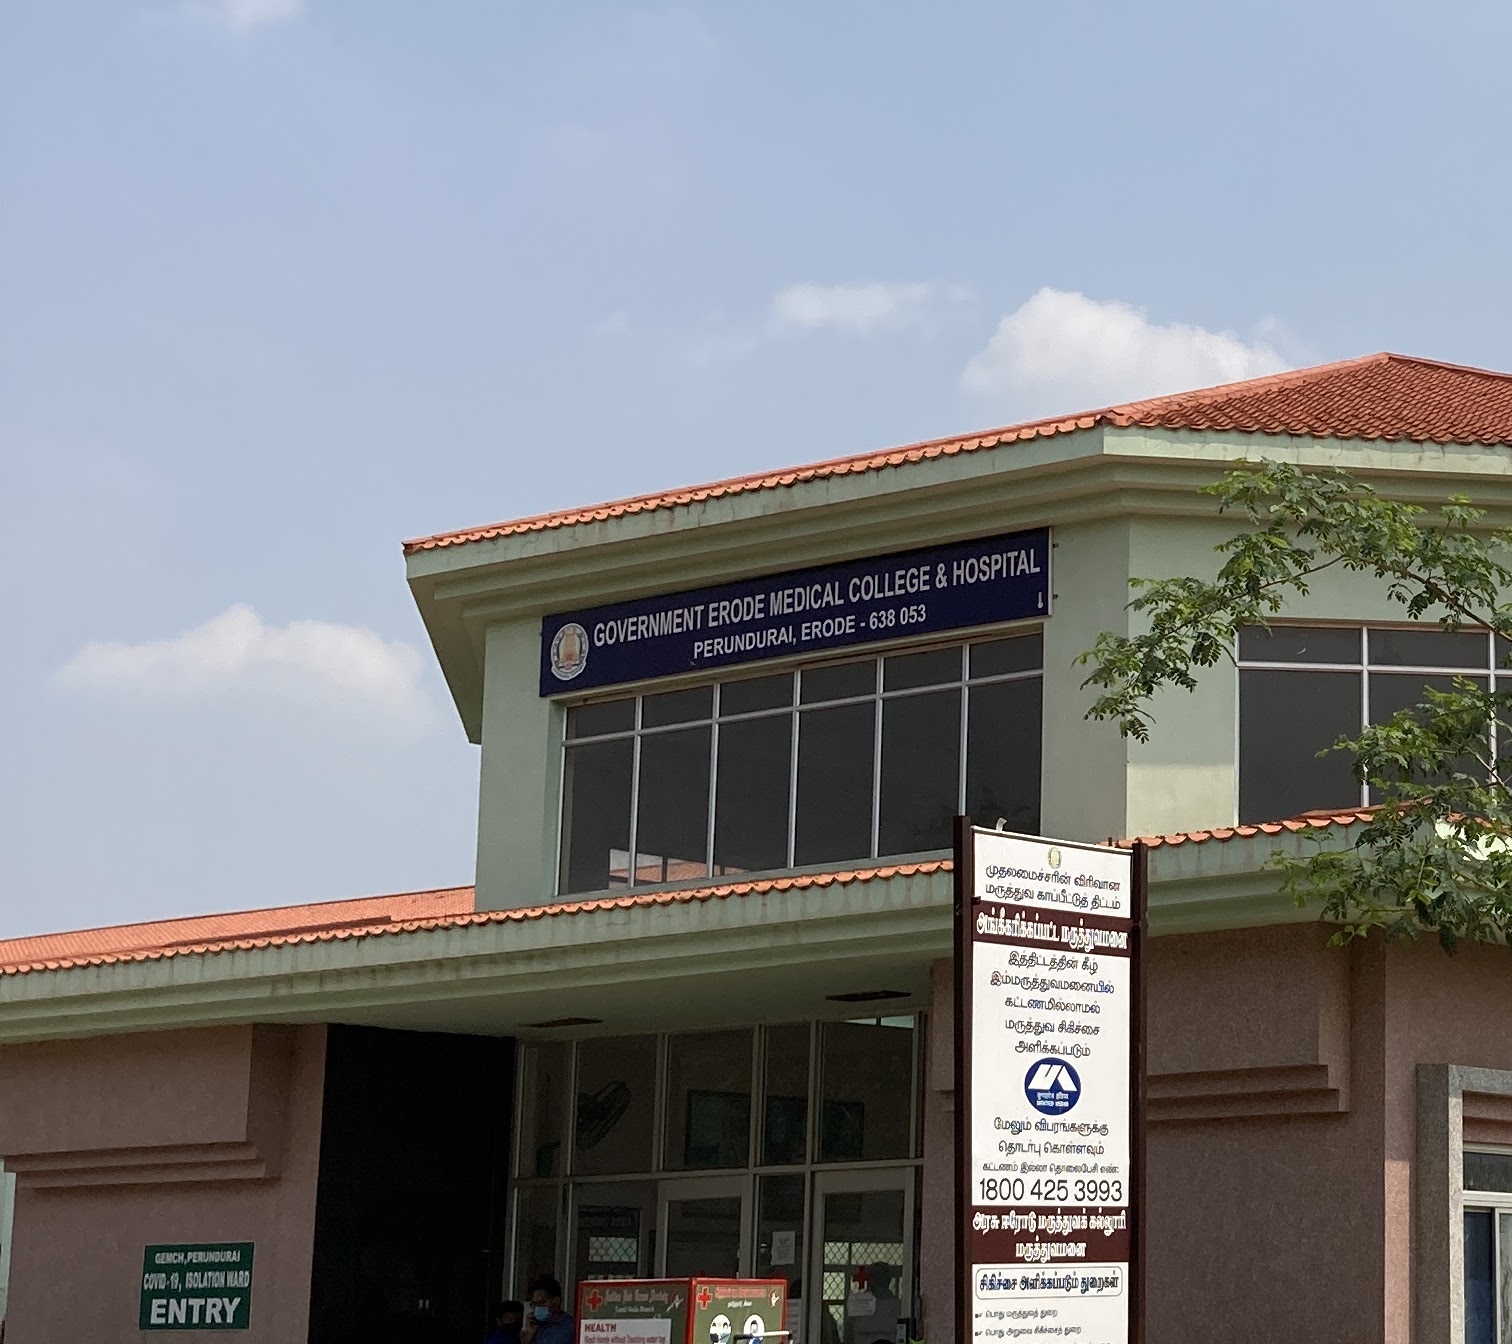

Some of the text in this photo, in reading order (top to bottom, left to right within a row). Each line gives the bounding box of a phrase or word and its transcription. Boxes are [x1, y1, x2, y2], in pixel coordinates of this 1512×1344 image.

[593, 548, 1040, 647] GOVERNMENT ERODE MEDICAL COLLEGE & HOSPITAL
[693, 624, 797, 659] PERUNDURAI,
[801, 615, 855, 641] ERODE
[869, 609, 896, 630] 638
[900, 604, 927, 626] 053
[986, 864, 1121, 891] முதலமைச்சரின் விரிவான
[986, 882, 1121, 911] மருத்துவ காப்பீட்டுத் திட்டம்
[976, 906, 1128, 952] அங்கீகரிக்கப்பட்ட மருத்துவமனை
[1008, 949, 1099, 975] இத்திட்டத்தின் கீழ்
[990, 970, 1115, 994] இம்மருத்துவமனையில்
[1004, 995, 1101, 1014] கட்டணமில்லாமல்
[1004, 1016, 1100, 1037] மருத்துவ சிகிச்சை
[1014, 1040, 1091, 1058] அளிக்கப்படும்
[993, 1116, 1109, 1137] மேலும் விபரங்களுக்கு
[998, 1138, 1105, 1158] தொடர்பு கொள்ளவும்
[979, 1177, 1123, 1202] 1800 425 3993
[972, 1206, 1126, 1237] அரசு ஈரோடு மருத்துவக் கல்லூரி
[1015, 1235, 1087, 1263] மருத்துவமனை
[185, 1270, 226, 1289] ISOLATION
[226, 1270, 250, 1288] WARD
[979, 1269, 1120, 1294] சிகிச்சை அளிக்கப்படும் துறைகள்
[150, 1297, 242, 1324] ENTRY
[584, 1323, 617, 1333] HEALTH
